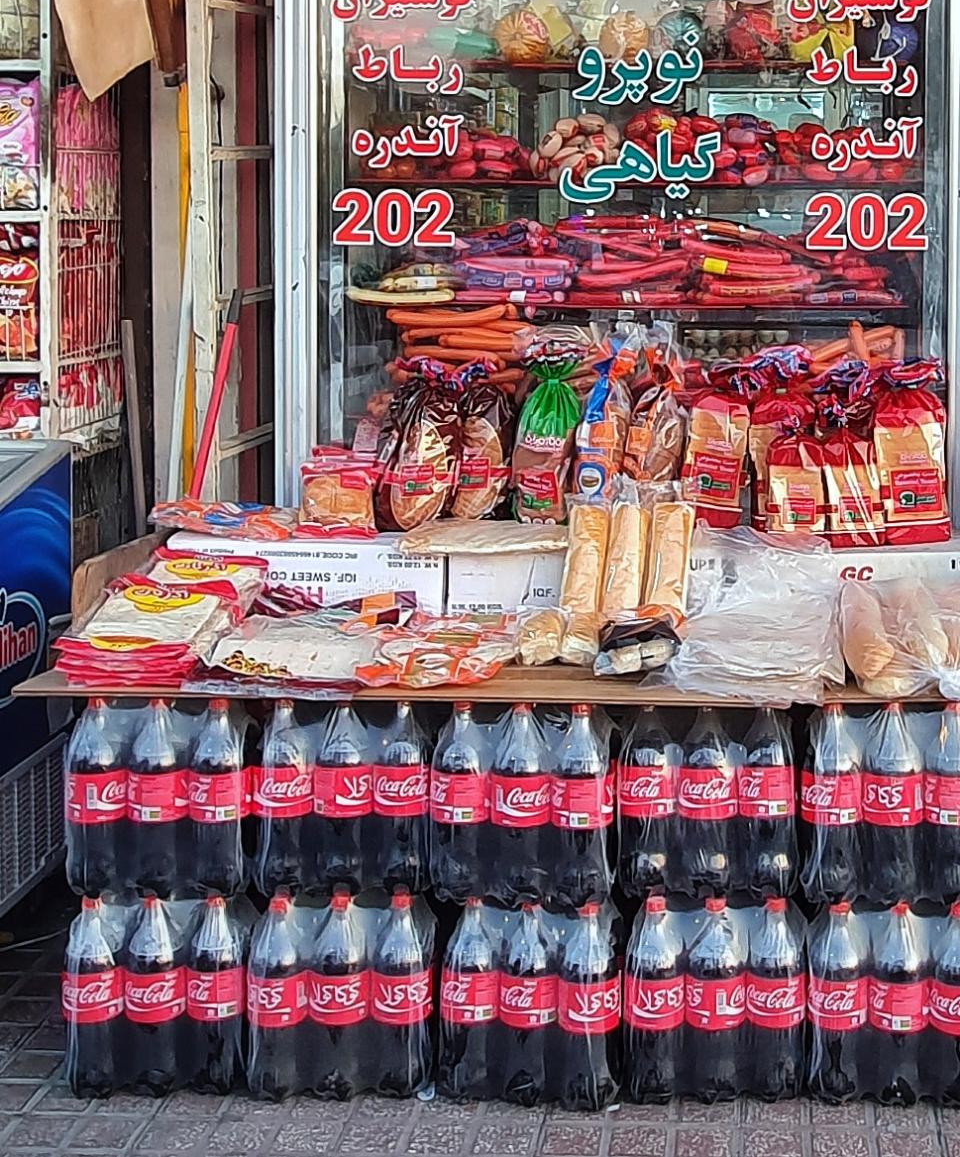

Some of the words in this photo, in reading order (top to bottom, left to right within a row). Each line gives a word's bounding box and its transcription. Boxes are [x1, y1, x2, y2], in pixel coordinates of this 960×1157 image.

[351, 45, 465, 95] رباط
[807, 44, 919, 98] رباط
[352, 115, 461, 168] آندره
[559, 130, 721, 204] گیاهی
[813, 116, 922, 170] آندره
[332, 189, 455, 247] 202
[806, 192, 929, 251] 202
[290, 571, 331, 582] SWEET
[0, 621, 37, 673] ihan
